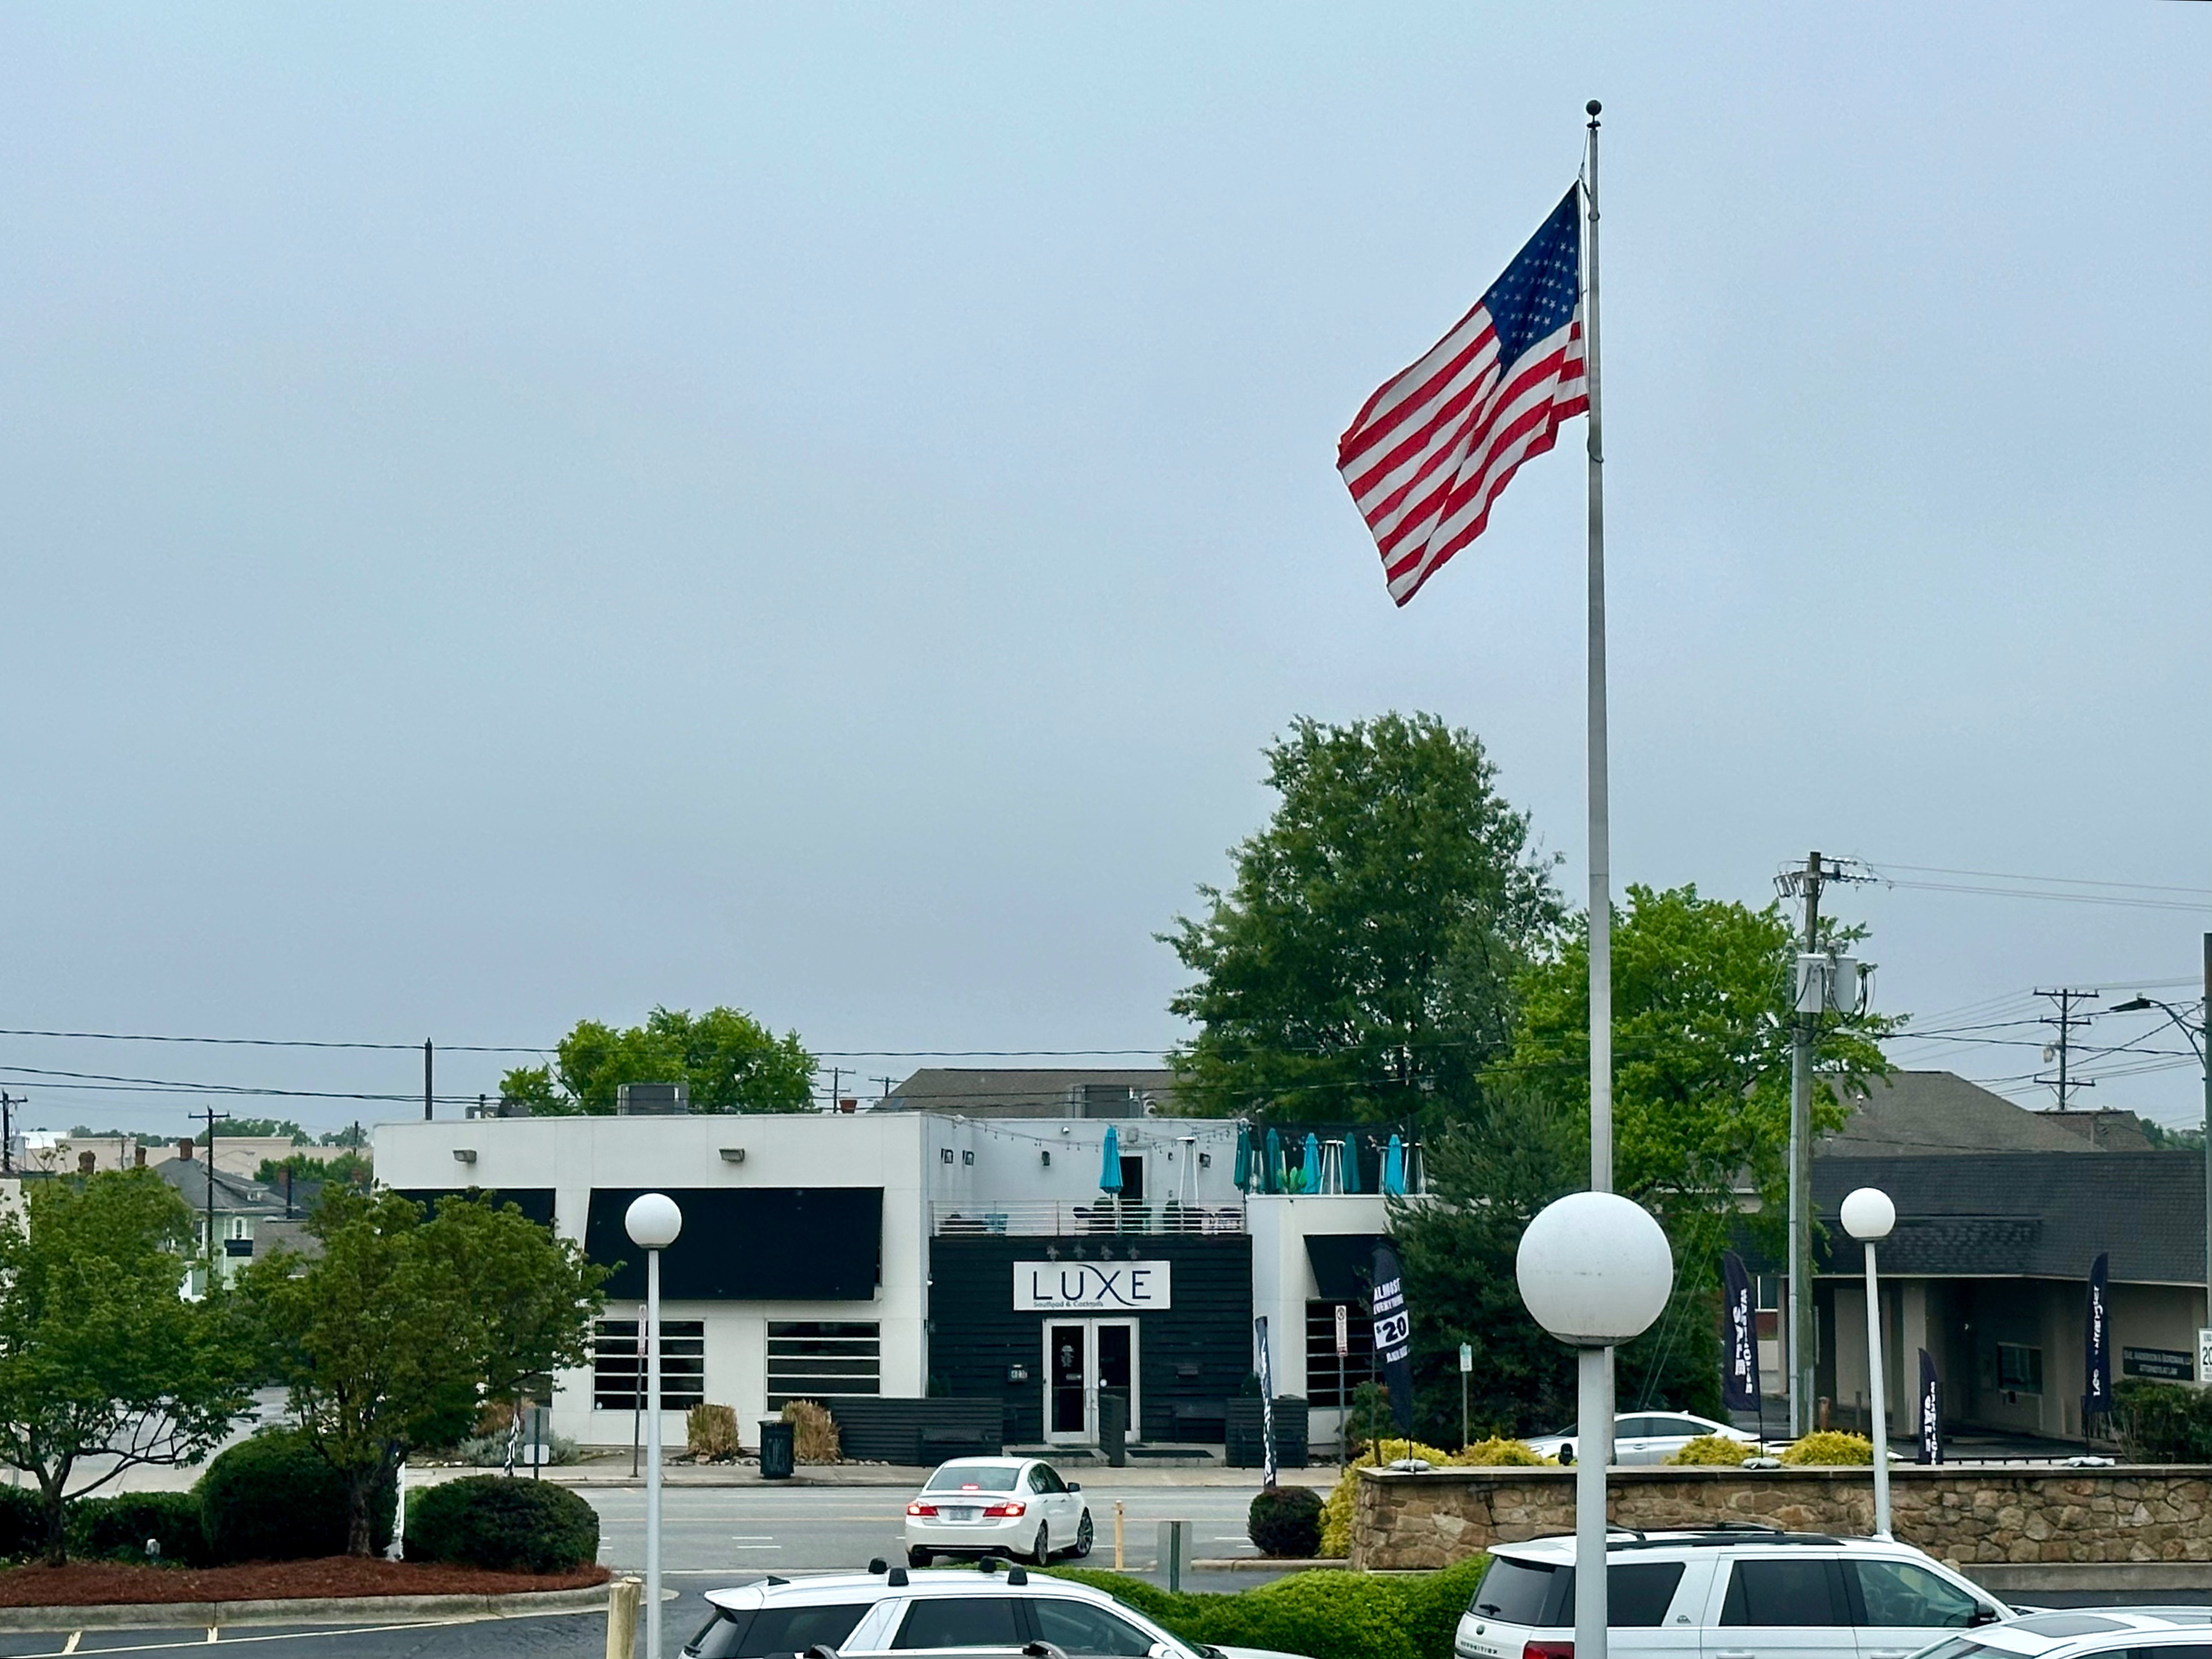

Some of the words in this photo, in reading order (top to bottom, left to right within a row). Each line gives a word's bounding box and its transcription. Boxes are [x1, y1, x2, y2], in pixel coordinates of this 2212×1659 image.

[1033, 1264, 1151, 1306] LUXE
[1373, 1277, 1401, 1302] ALMOST
[1376, 1316, 1406, 1343] $20
